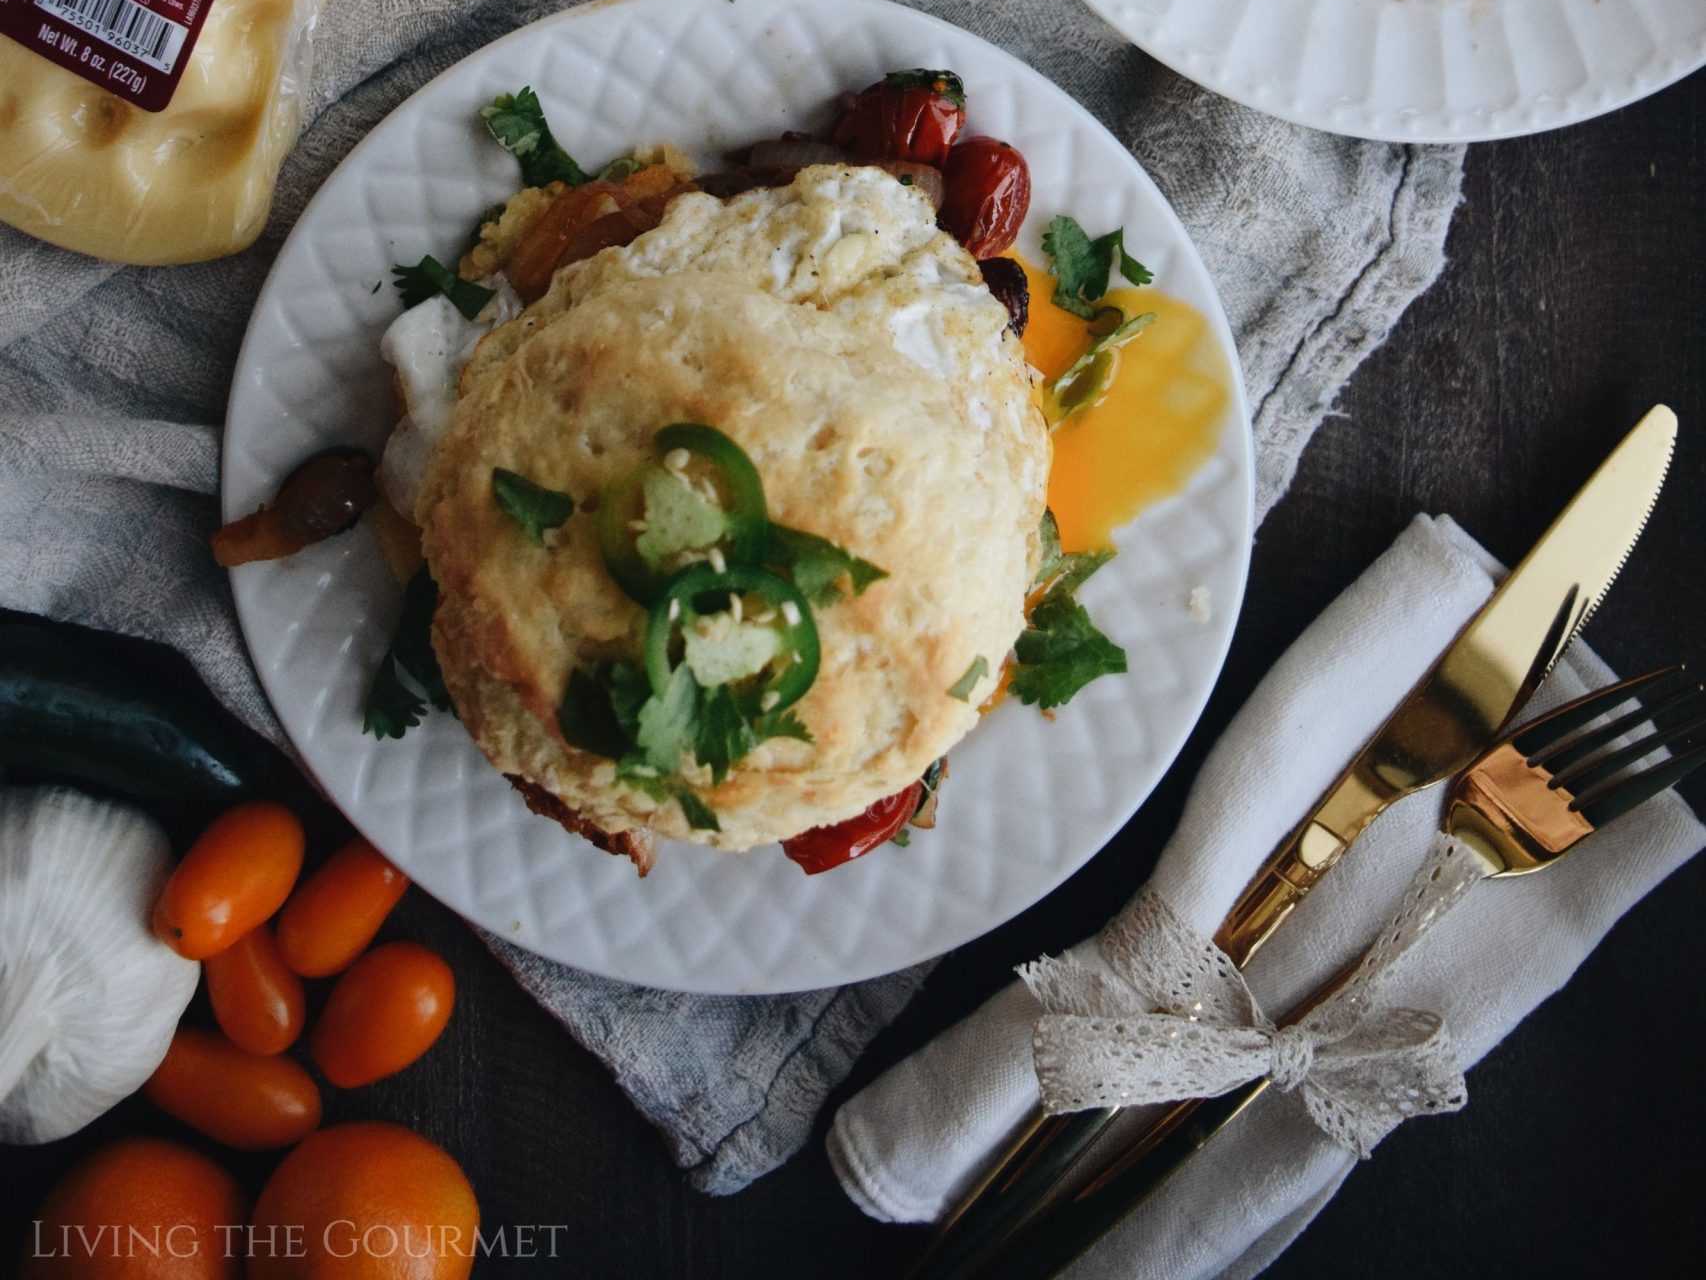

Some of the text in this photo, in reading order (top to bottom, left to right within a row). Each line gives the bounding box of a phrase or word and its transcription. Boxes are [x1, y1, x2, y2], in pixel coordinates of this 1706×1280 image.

[38, 23, 148, 95] Net Wt. 8 oz. (227g)
[60, 7, 101, 34] 75501
[106, 31, 148, 59] 96037
